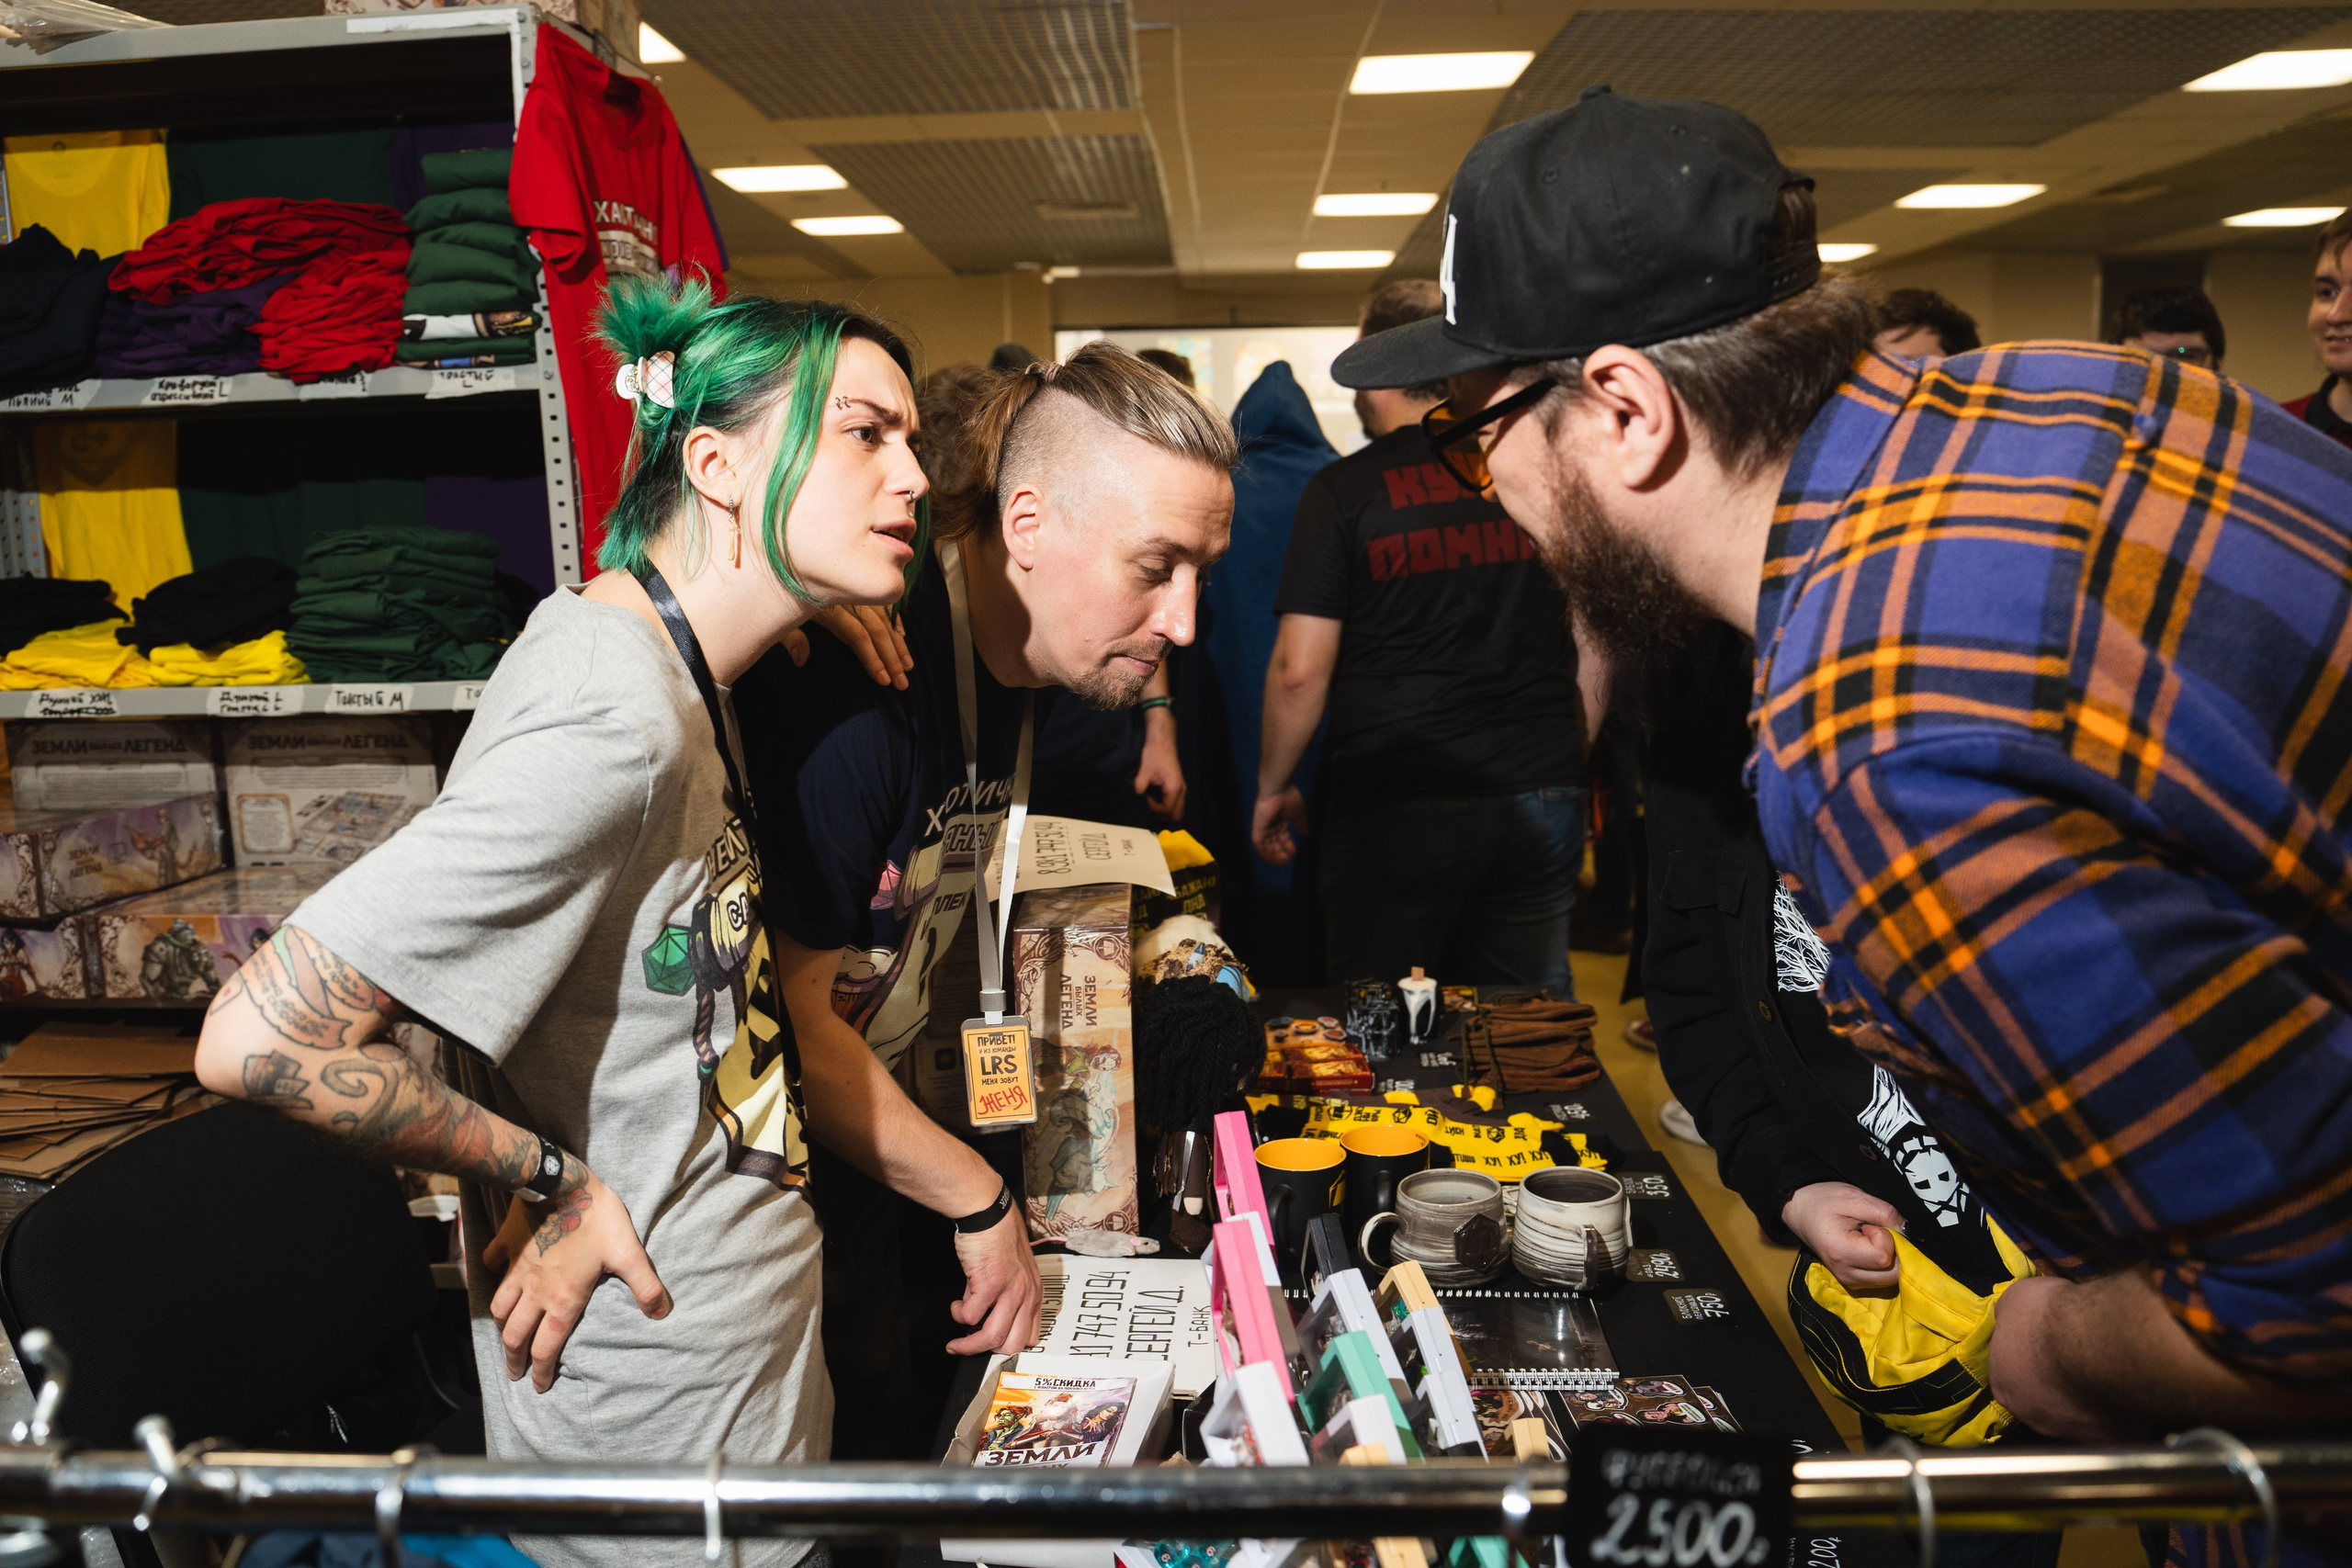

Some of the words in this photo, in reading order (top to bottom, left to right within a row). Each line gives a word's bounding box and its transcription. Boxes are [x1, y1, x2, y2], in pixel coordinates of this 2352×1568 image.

[32, 739, 88, 755] ЗЕМЛИ
[123, 738, 187, 753] ЛЕГЕНД
[1060, 972, 1073, 1032] ЛЕГЕНД
[1084, 975, 1098, 1027] ЗЕМЛИ
[978, 1033, 1016, 1047] ПРИВЕТ!
[980, 1055, 1018, 1076] LRS
[981, 1077, 999, 1086] МЕНЯ
[1000, 1076, 1019, 1084] ЗОВУТ
[978, 1085, 1028, 1115] ЖЕНЯ
[1453, 1154, 1476, 1164] TUDIO
[1085, 1269, 1131, 1290] 94
[1080, 1291, 1125, 1312] 50
[1072, 1314, 1118, 1341] 747
[1053, 1378, 1096, 1388] СКИДКА
[985, 1442, 1098, 1468] ЗЕМЛИ
